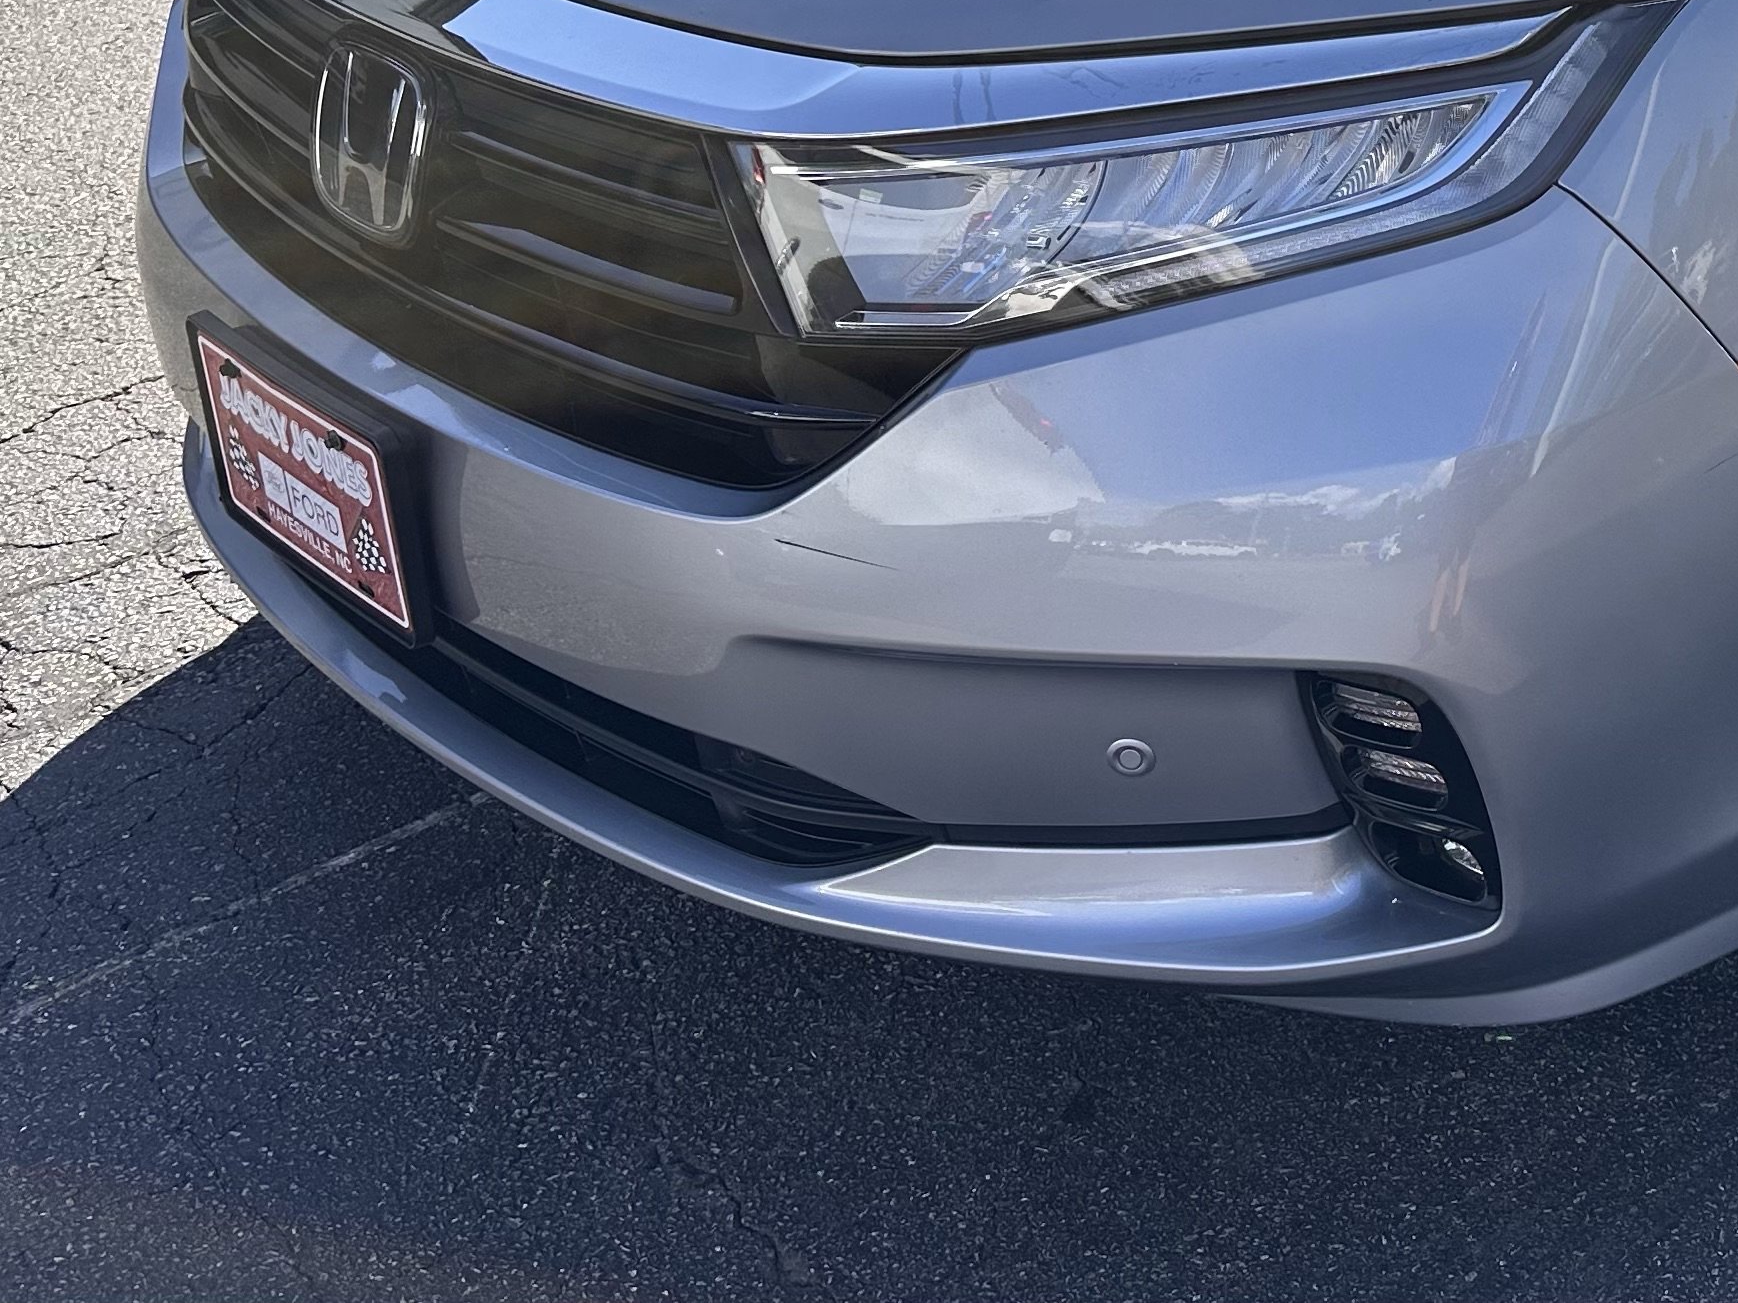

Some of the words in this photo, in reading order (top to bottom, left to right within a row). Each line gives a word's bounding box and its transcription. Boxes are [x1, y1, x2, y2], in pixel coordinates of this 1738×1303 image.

[219, 371, 290, 454] JACKY
[289, 419, 373, 508] JONES
[267, 500, 336, 564] HAYESVILLE,
[335, 550, 353, 574] NC
[290, 485, 339, 537] FORD
